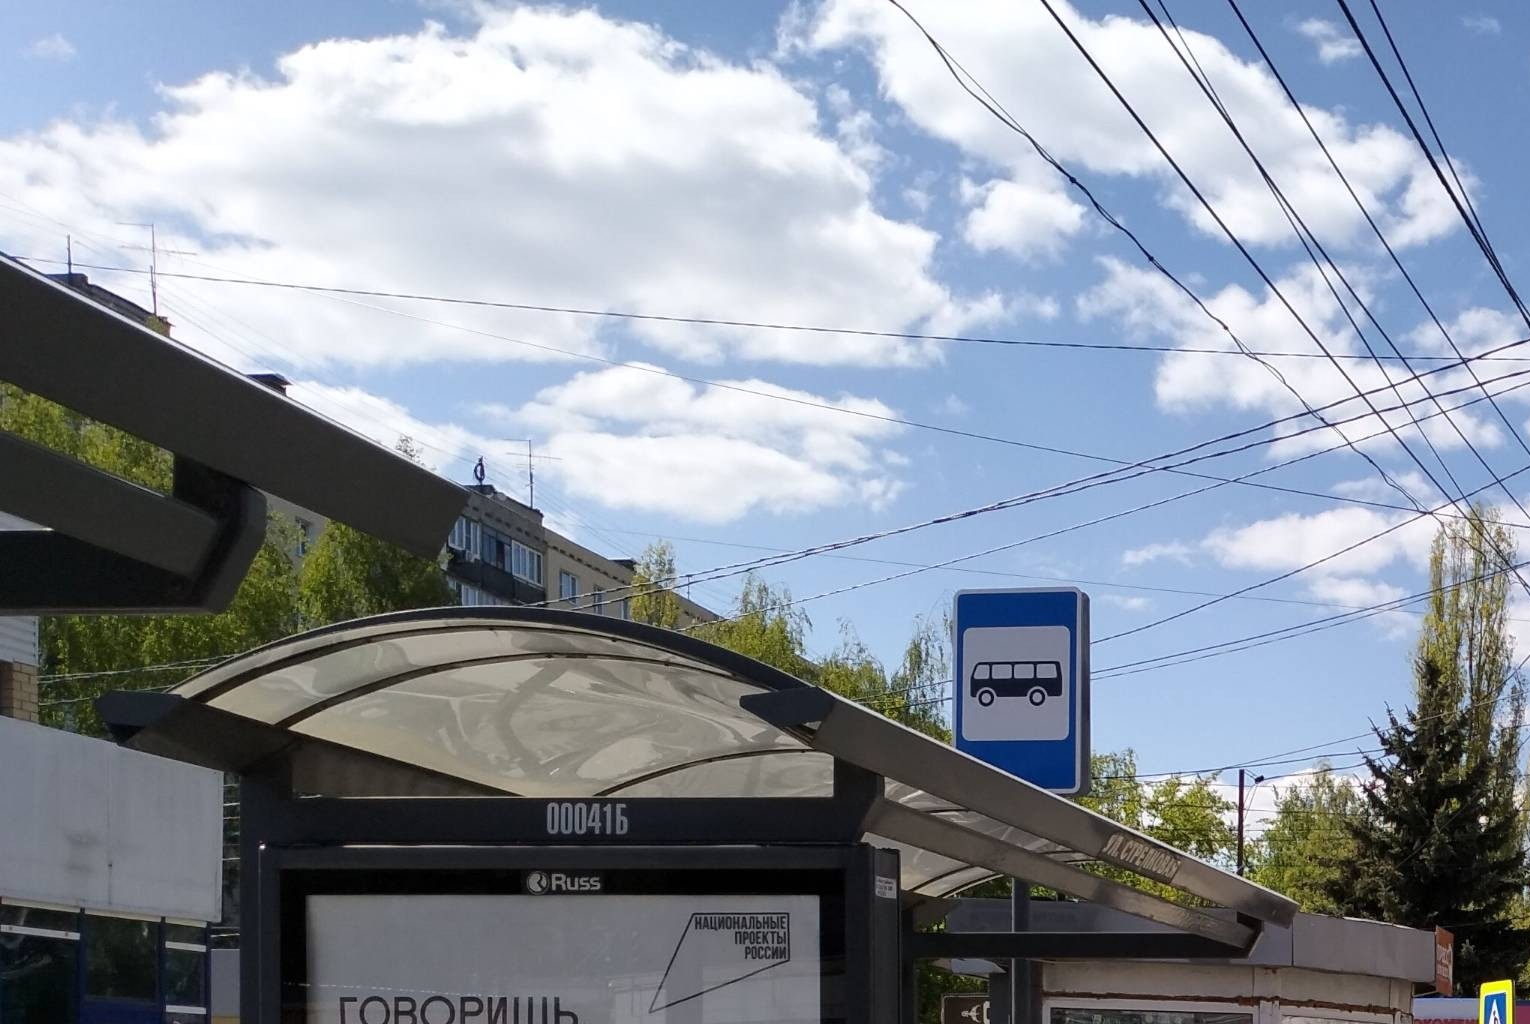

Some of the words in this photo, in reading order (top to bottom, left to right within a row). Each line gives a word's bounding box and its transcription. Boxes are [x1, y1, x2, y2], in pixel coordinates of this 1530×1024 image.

[551, 873, 601, 891] Russ
[694, 915, 787, 931] НАЦИОНАЛЬНЫЕ
[734, 931, 787, 945] ПРОЕКТЫ
[744, 946, 787, 960] РОССИИ
